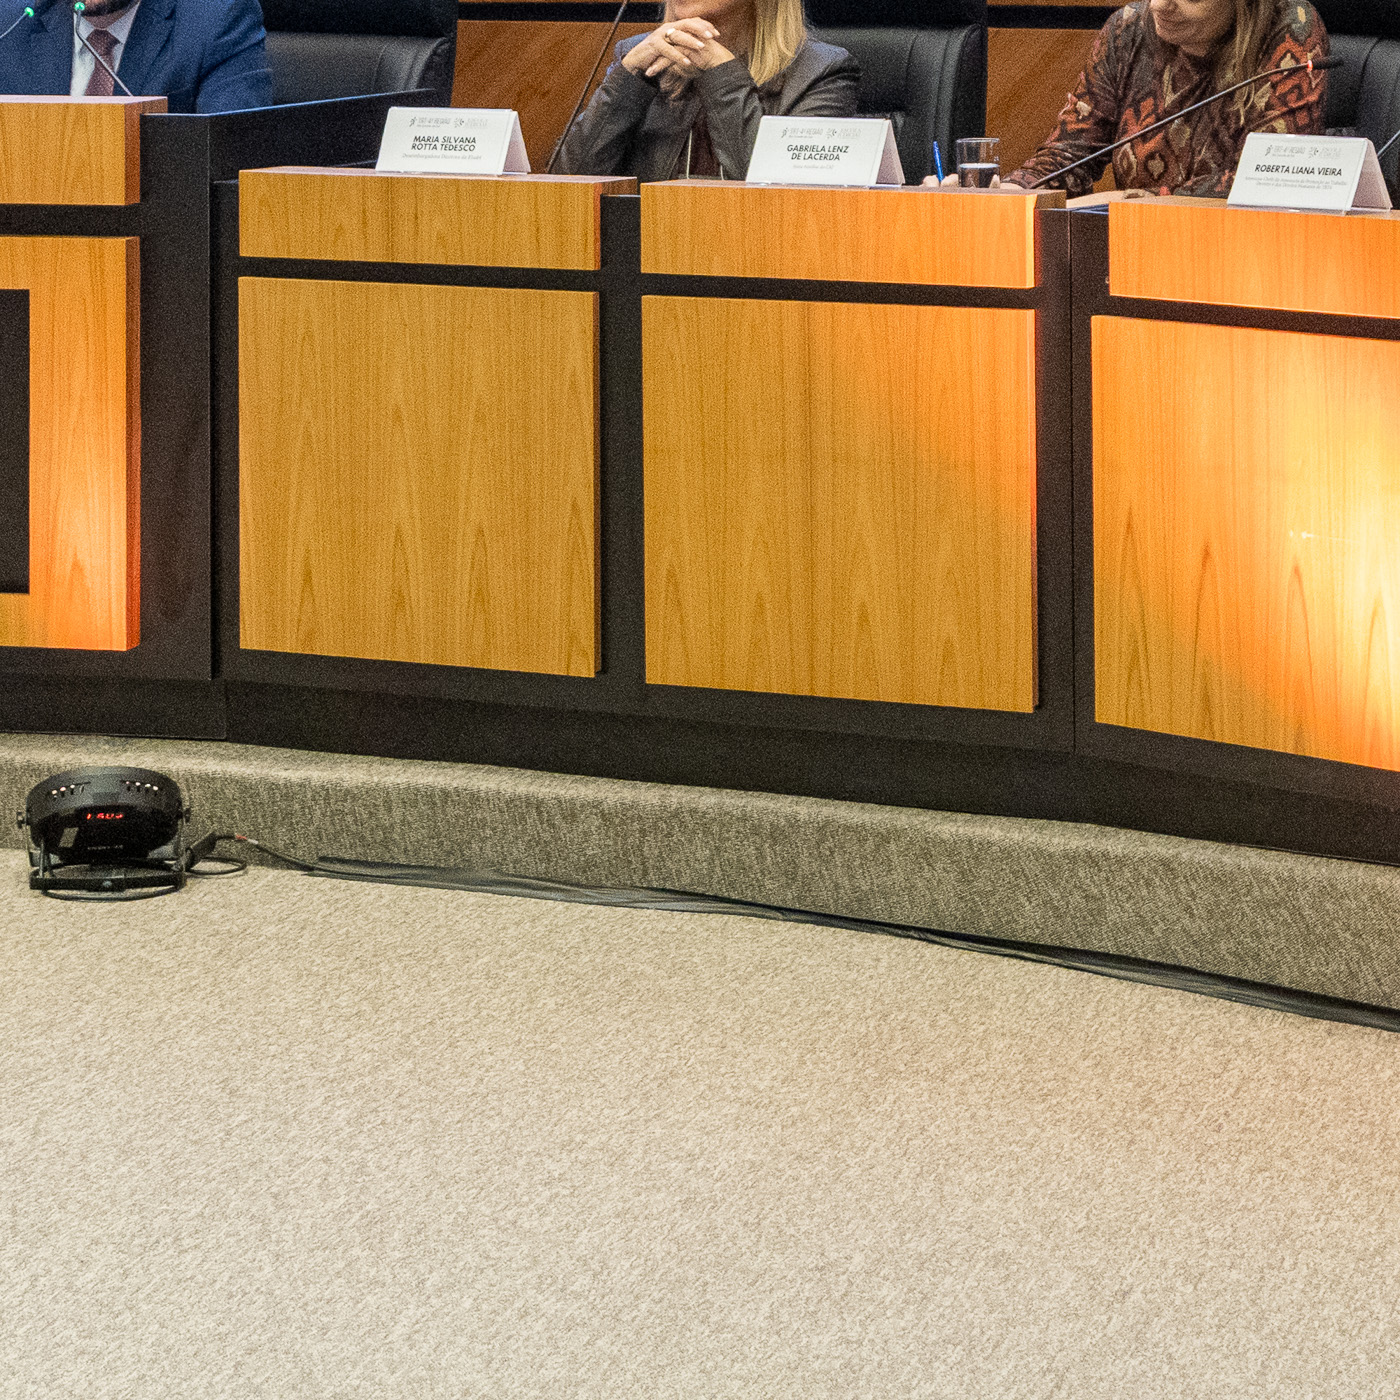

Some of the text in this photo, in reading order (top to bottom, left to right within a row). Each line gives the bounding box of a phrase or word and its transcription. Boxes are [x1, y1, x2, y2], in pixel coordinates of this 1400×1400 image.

[413, 135, 476, 144] MARIA SILVANA
[440, 143, 476, 152] TEDESCO
[787, 144, 849, 153] GABRIELA LENZ
[791, 152, 840, 161] DE LACERDA
[1255, 164, 1342, 176] ROBERTA LIANA VIEIRA
